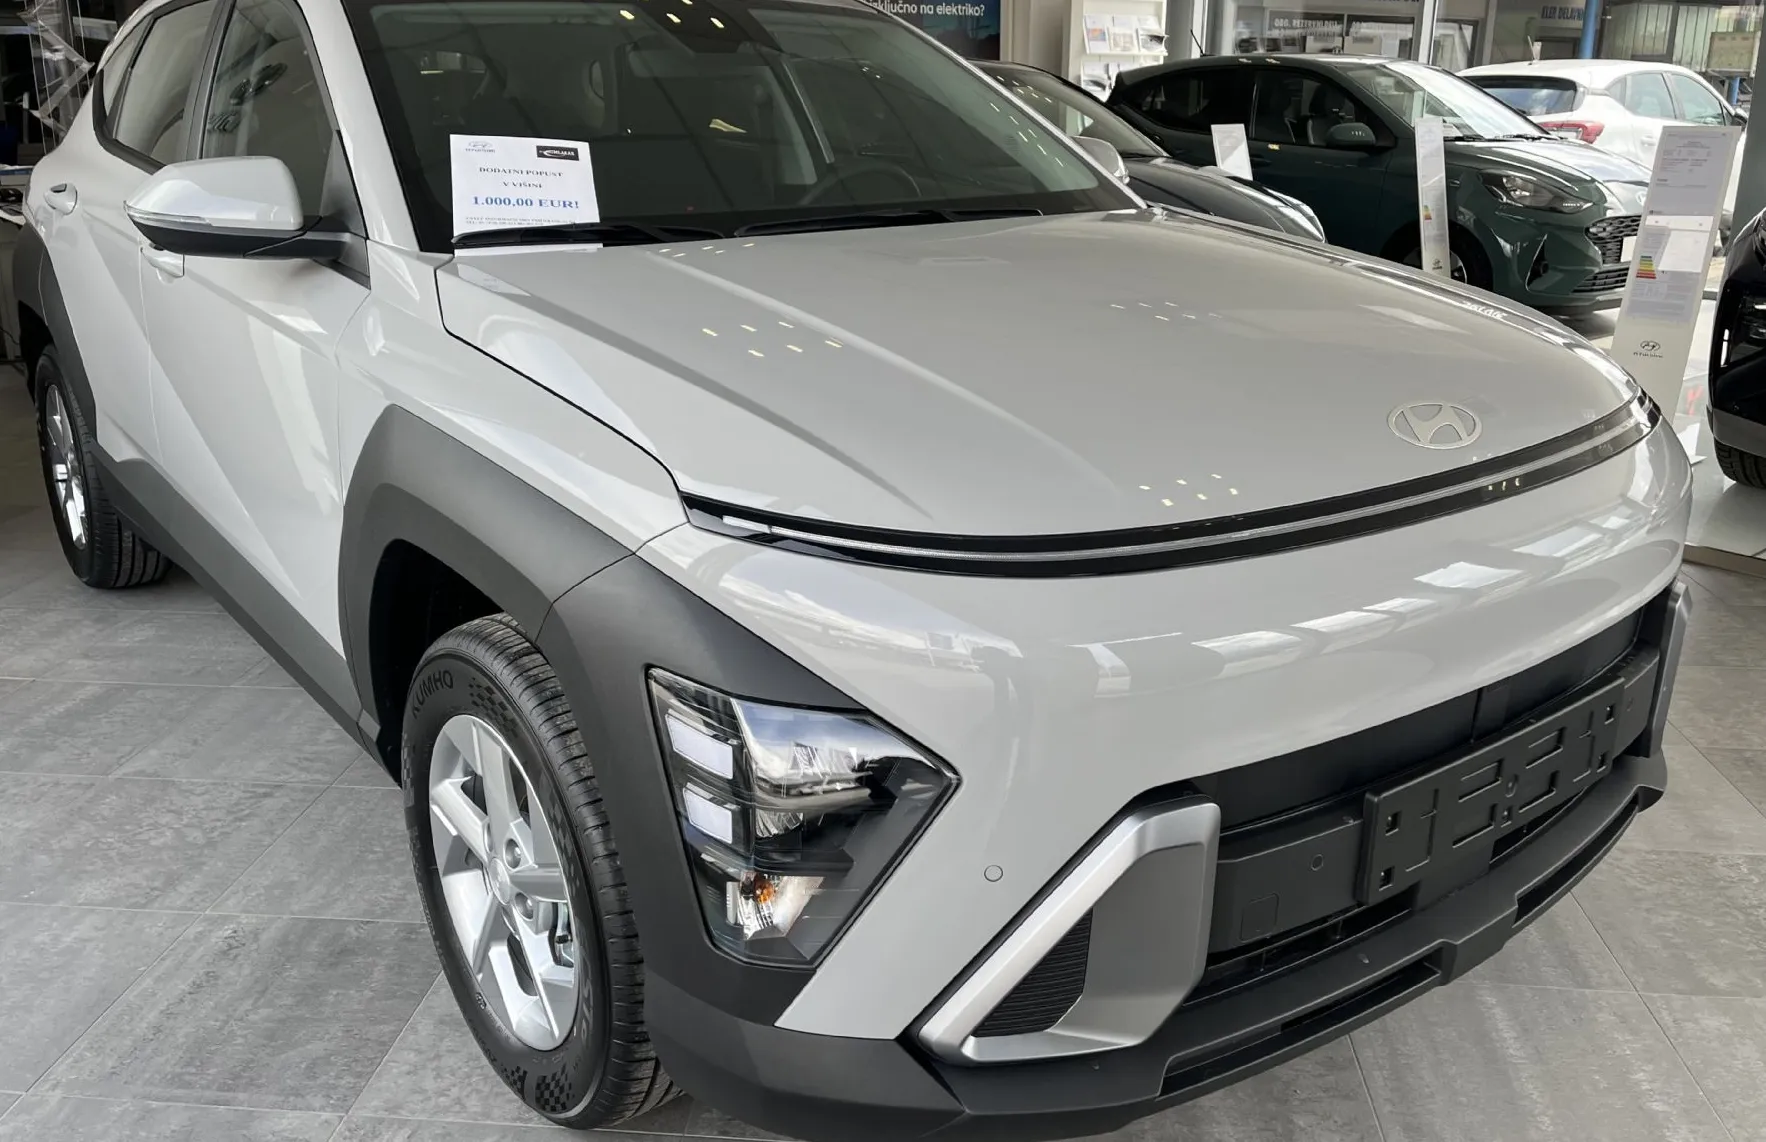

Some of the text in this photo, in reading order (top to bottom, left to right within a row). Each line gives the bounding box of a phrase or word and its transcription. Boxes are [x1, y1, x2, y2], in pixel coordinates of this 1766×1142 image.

[920, 5, 934, 14] na
[936, 3, 985, 16] elektriko?
[479, 167, 564, 177] DODATNI POPUST
[473, 196, 579, 209] 1.000,00 EUR!
[412, 670, 454, 720] KUMHO
